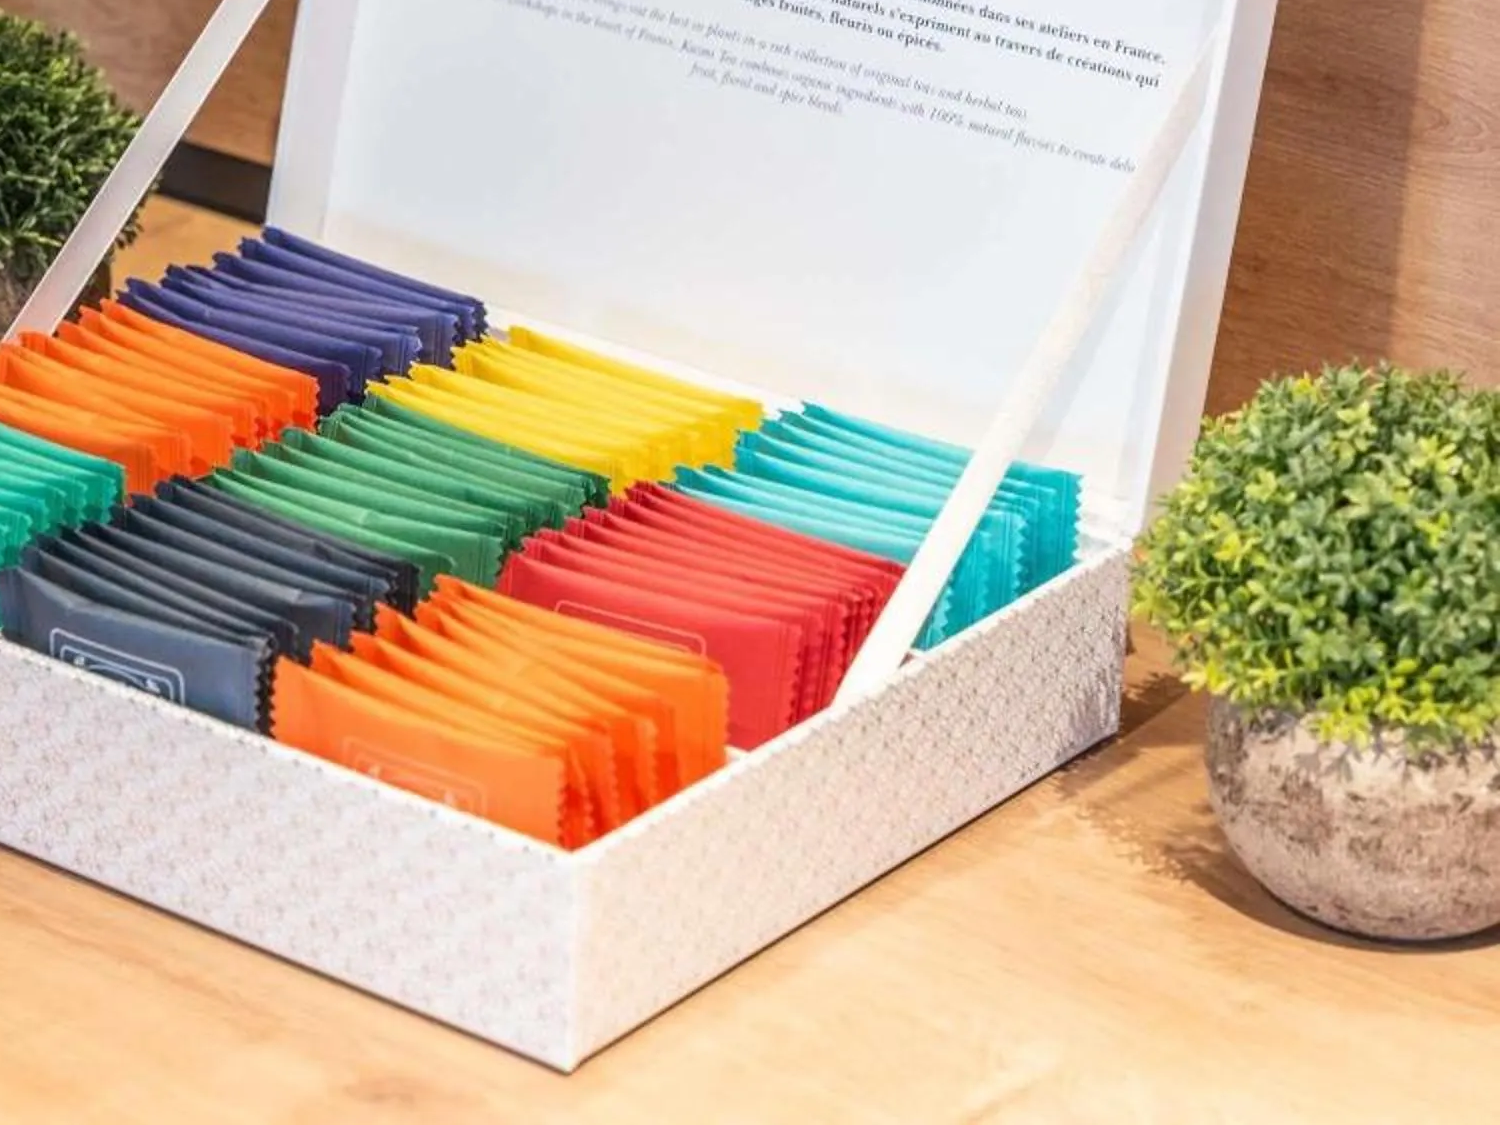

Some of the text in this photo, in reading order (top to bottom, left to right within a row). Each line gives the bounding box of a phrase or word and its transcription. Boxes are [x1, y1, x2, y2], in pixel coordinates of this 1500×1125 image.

[830, 10, 873, 35] fleuris
[877, 26, 894, 40] ou
[897, 31, 946, 53] épicés.
[979, 5, 1010, 25] dans
[1015, 17, 1034, 30] ses
[1039, 23, 1089, 44] ateliers
[1093, 38, 1111, 50] en
[1114, 39, 1165, 65] France.
[974, 32, 992, 44] au
[994, 35, 1042, 57] travers
[1045, 47, 1063, 63] de
[1067, 56, 1132, 81] créations
[1135, 73, 1161, 88] qui
